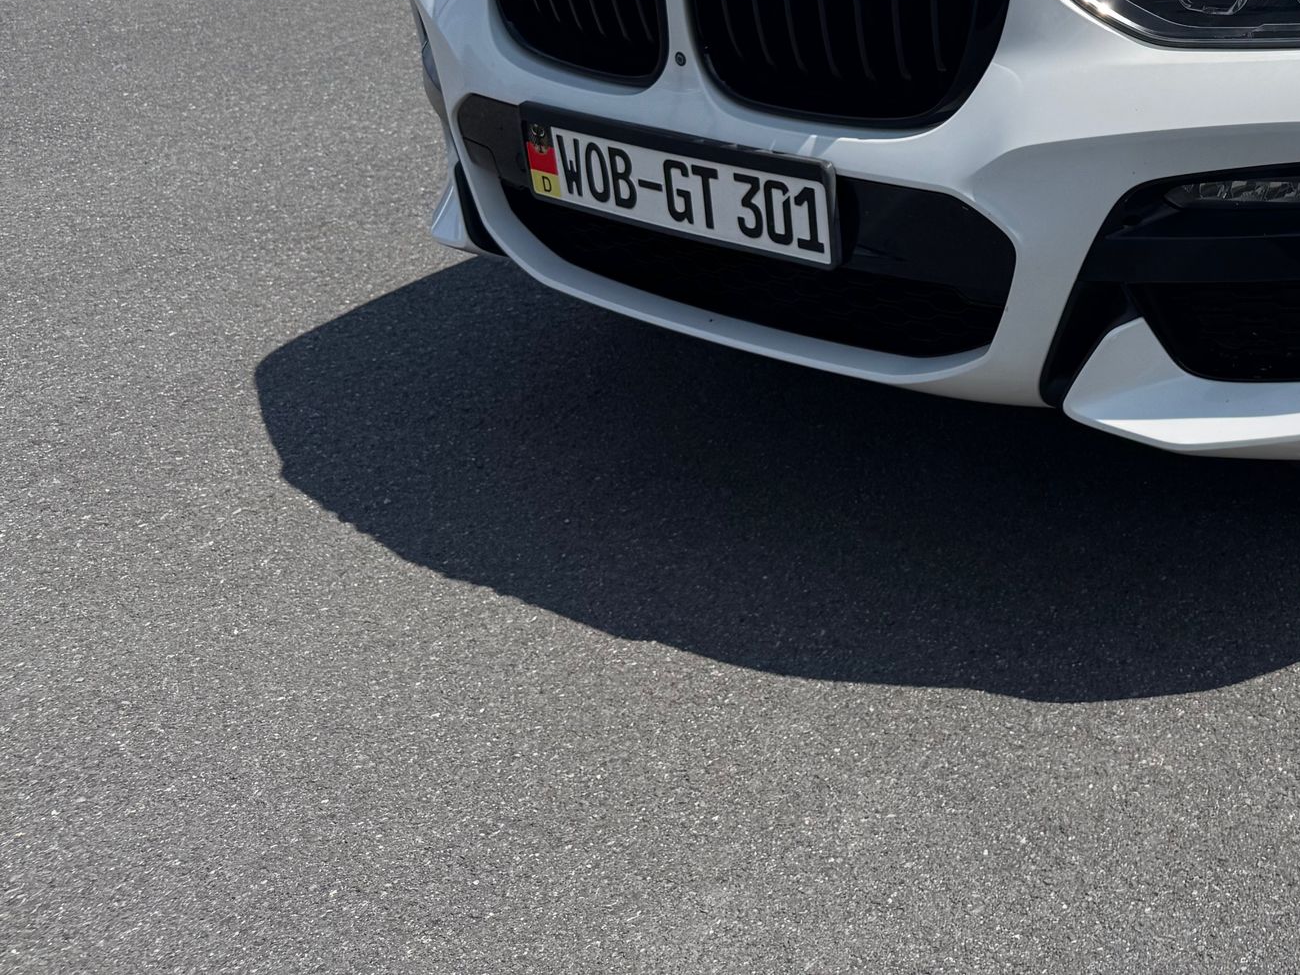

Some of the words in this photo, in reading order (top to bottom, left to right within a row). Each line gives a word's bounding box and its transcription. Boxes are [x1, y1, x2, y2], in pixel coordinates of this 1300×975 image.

[541, 175, 553, 193] D
[556, 134, 719, 229] WOB-GT
[733, 172, 825, 254] 301
